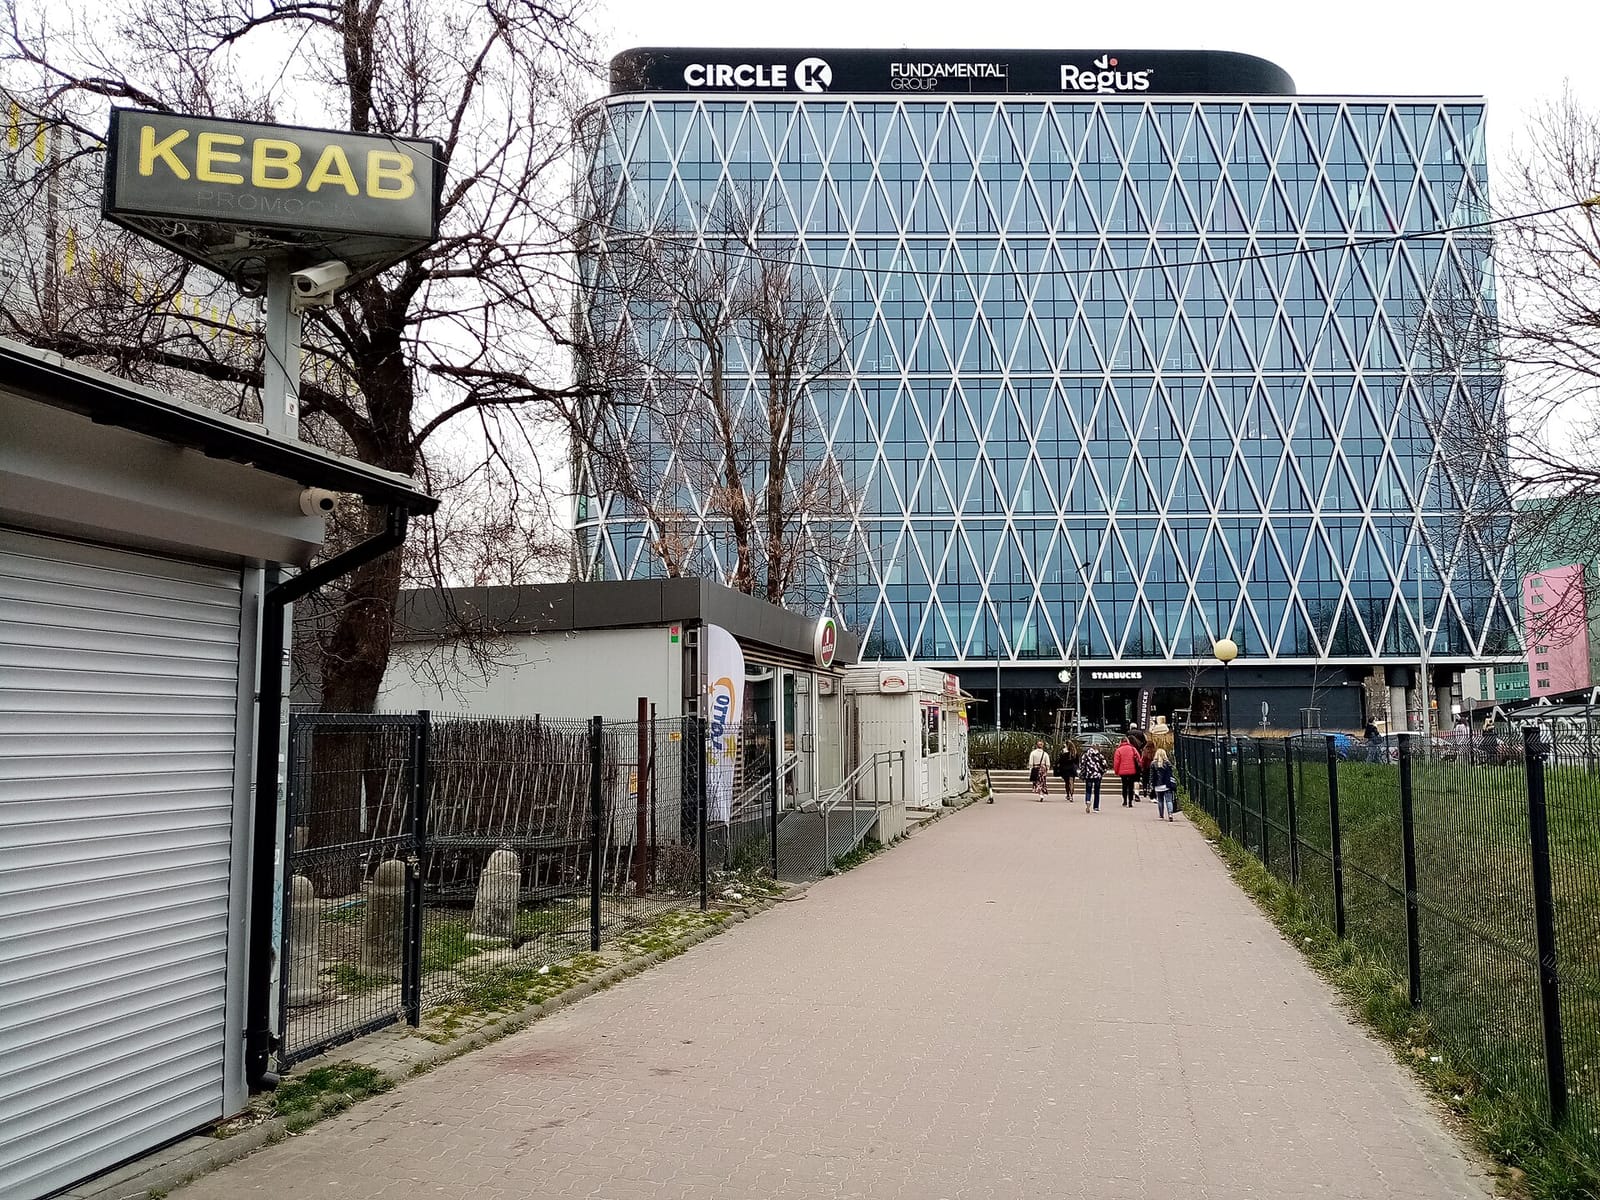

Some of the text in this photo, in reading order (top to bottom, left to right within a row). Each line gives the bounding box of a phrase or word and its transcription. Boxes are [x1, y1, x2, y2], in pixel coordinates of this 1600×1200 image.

[684, 63, 831, 91] CIRCLE K
[890, 63, 1005, 77] FUNDAMENTAL
[890, 77, 938, 90] GROUP
[1060, 64, 1150, 93] Regus
[138, 125, 416, 200] KEBAB
[1140, 691, 1149, 730] STARBUCKS
